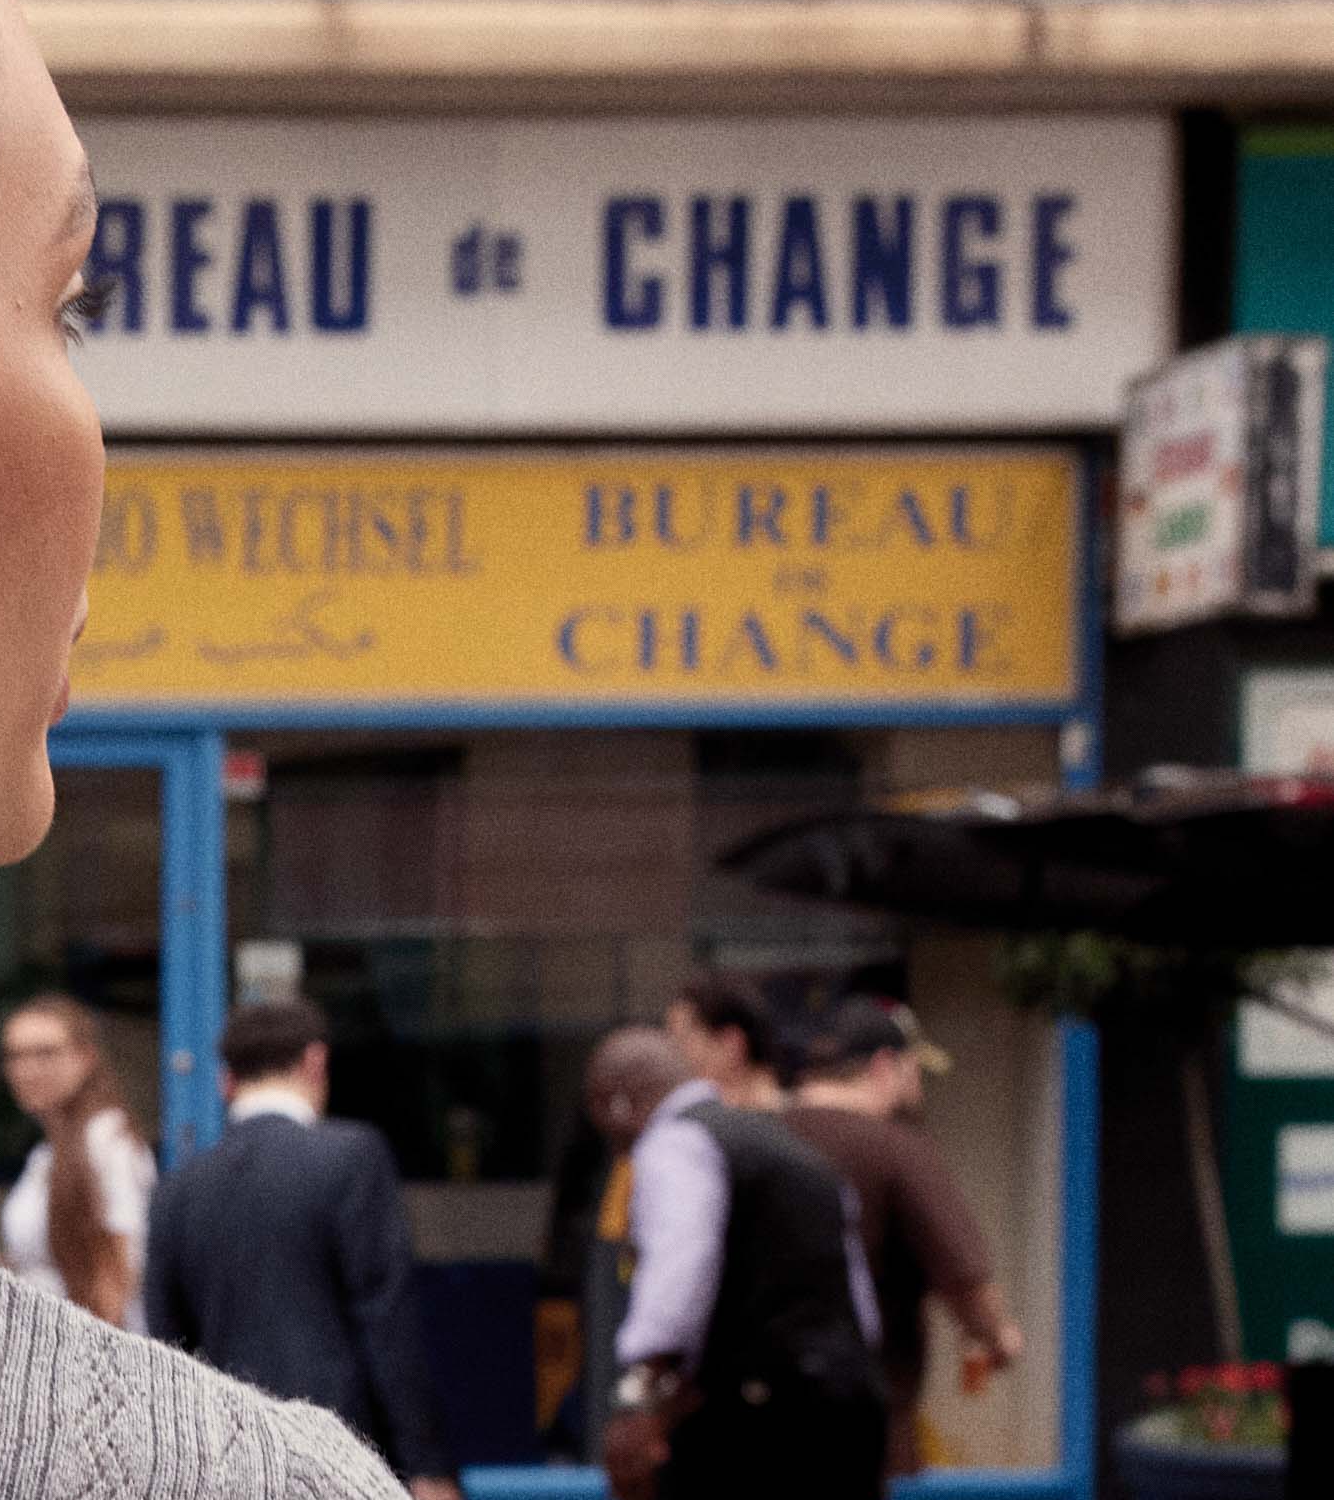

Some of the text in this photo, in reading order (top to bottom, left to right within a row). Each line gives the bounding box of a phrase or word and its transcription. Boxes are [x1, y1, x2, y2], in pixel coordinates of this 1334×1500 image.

[86, 193, 1078, 336] REAU de CHANGE
[580, 480, 1020, 550] BUREAU
[554, 604, 1018, 674] CHANGE
